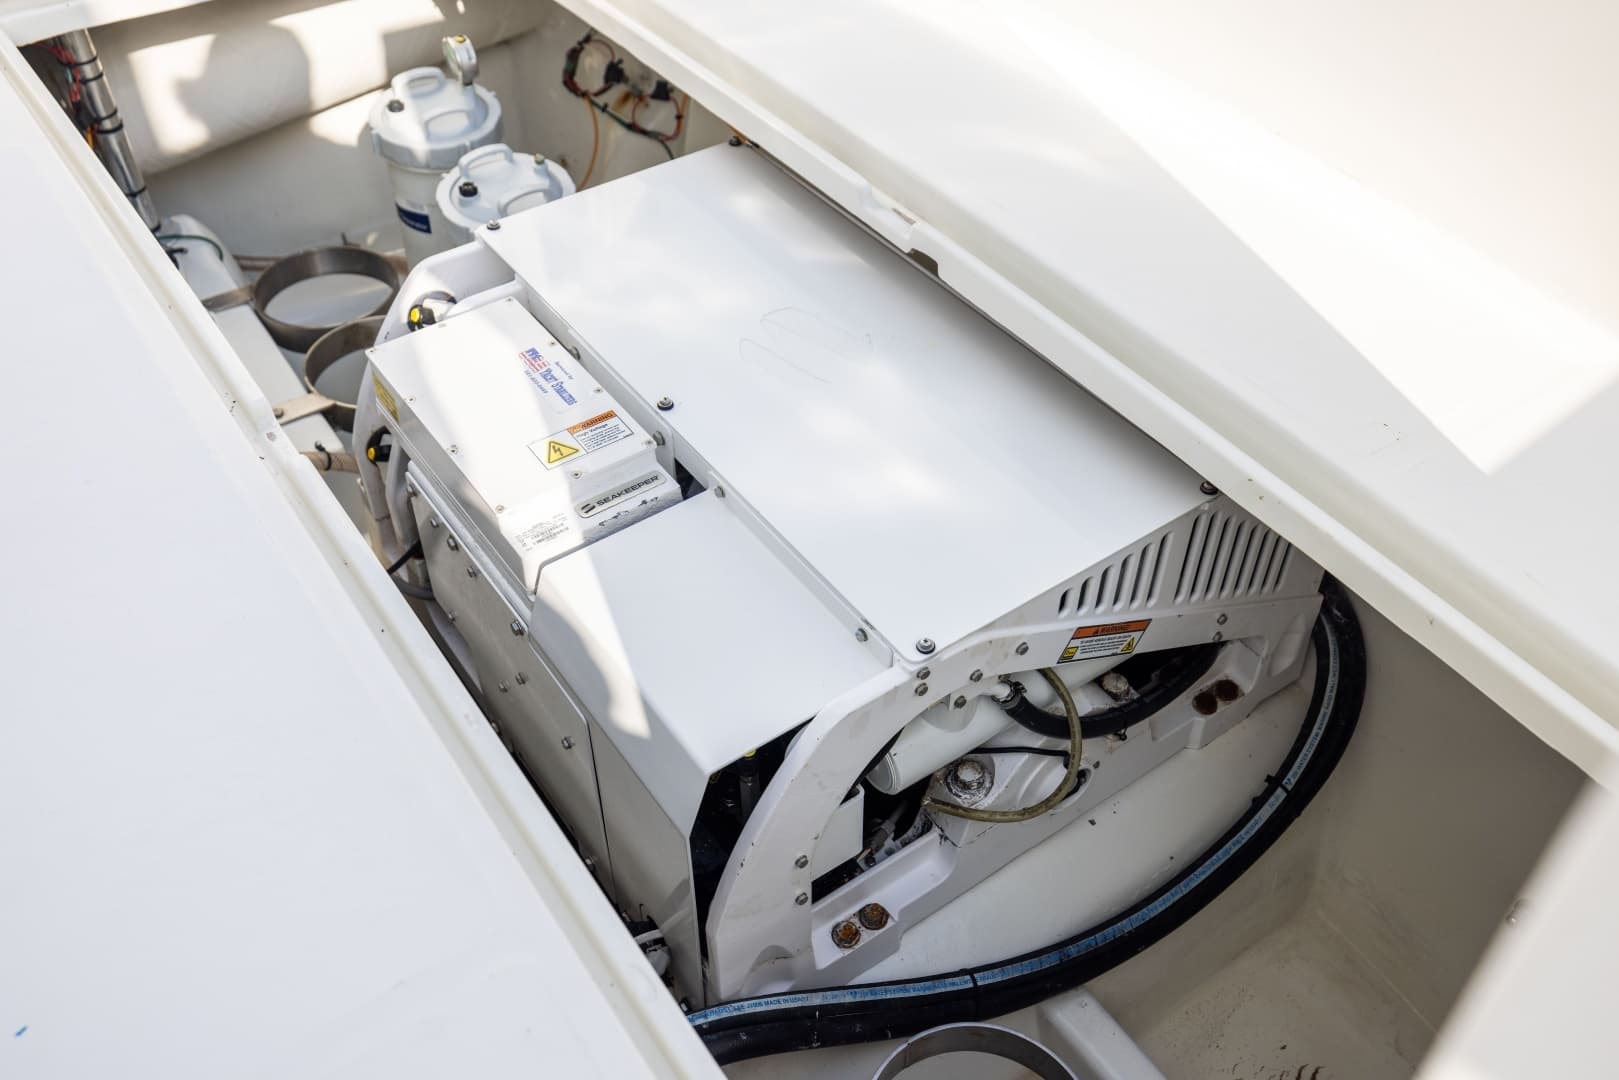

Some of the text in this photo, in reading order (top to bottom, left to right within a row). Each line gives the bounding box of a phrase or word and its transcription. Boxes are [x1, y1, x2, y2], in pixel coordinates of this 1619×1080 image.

[581, 412, 614, 429] WARNING
[596, 474, 660, 507] SEAKEEPER
[764, 998, 783, 1006] MADE
